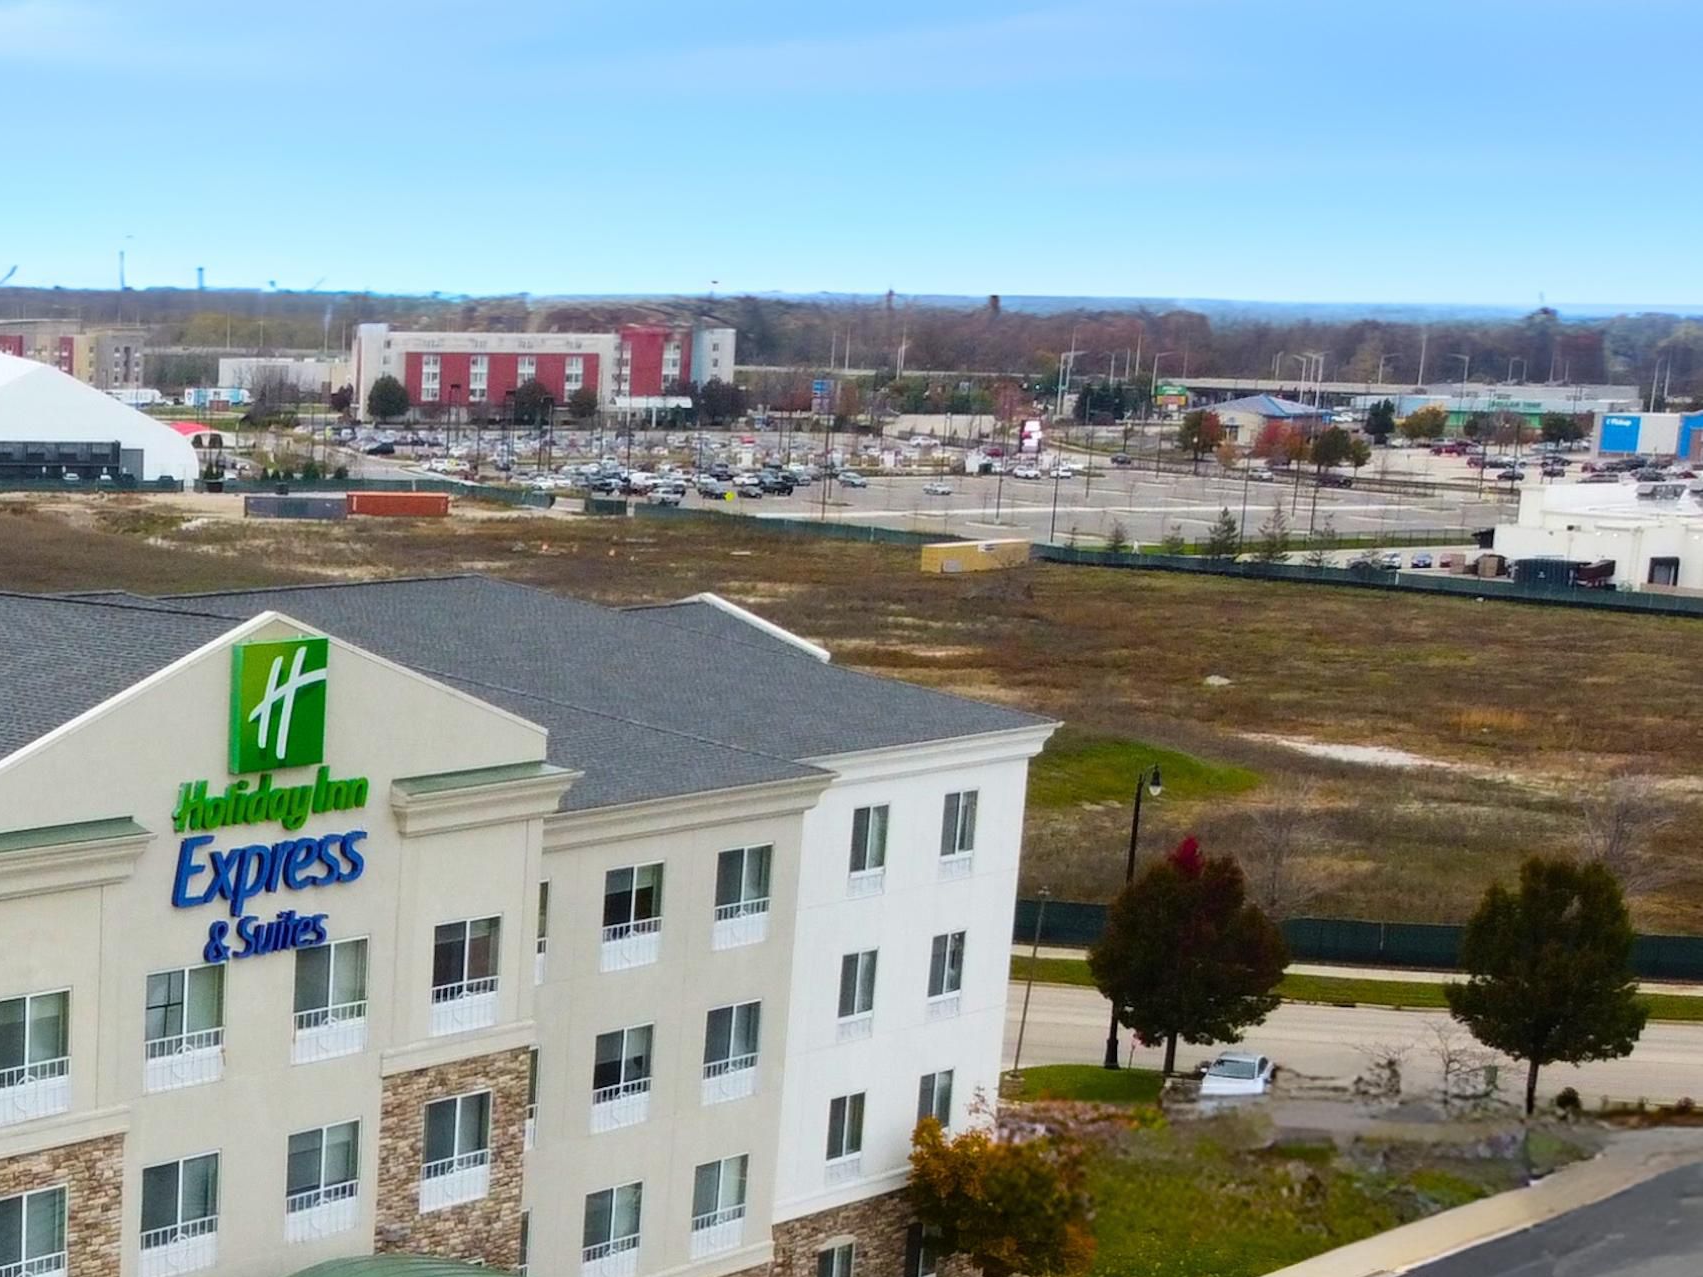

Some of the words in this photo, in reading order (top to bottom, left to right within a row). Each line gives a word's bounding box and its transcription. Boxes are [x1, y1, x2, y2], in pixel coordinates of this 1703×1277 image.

[172, 774, 313, 831] Holiday
[312, 765, 369, 814] Inn
[171, 831, 368, 917] Express
[203, 921, 230, 963] &
[232, 910, 329, 959] Suites
